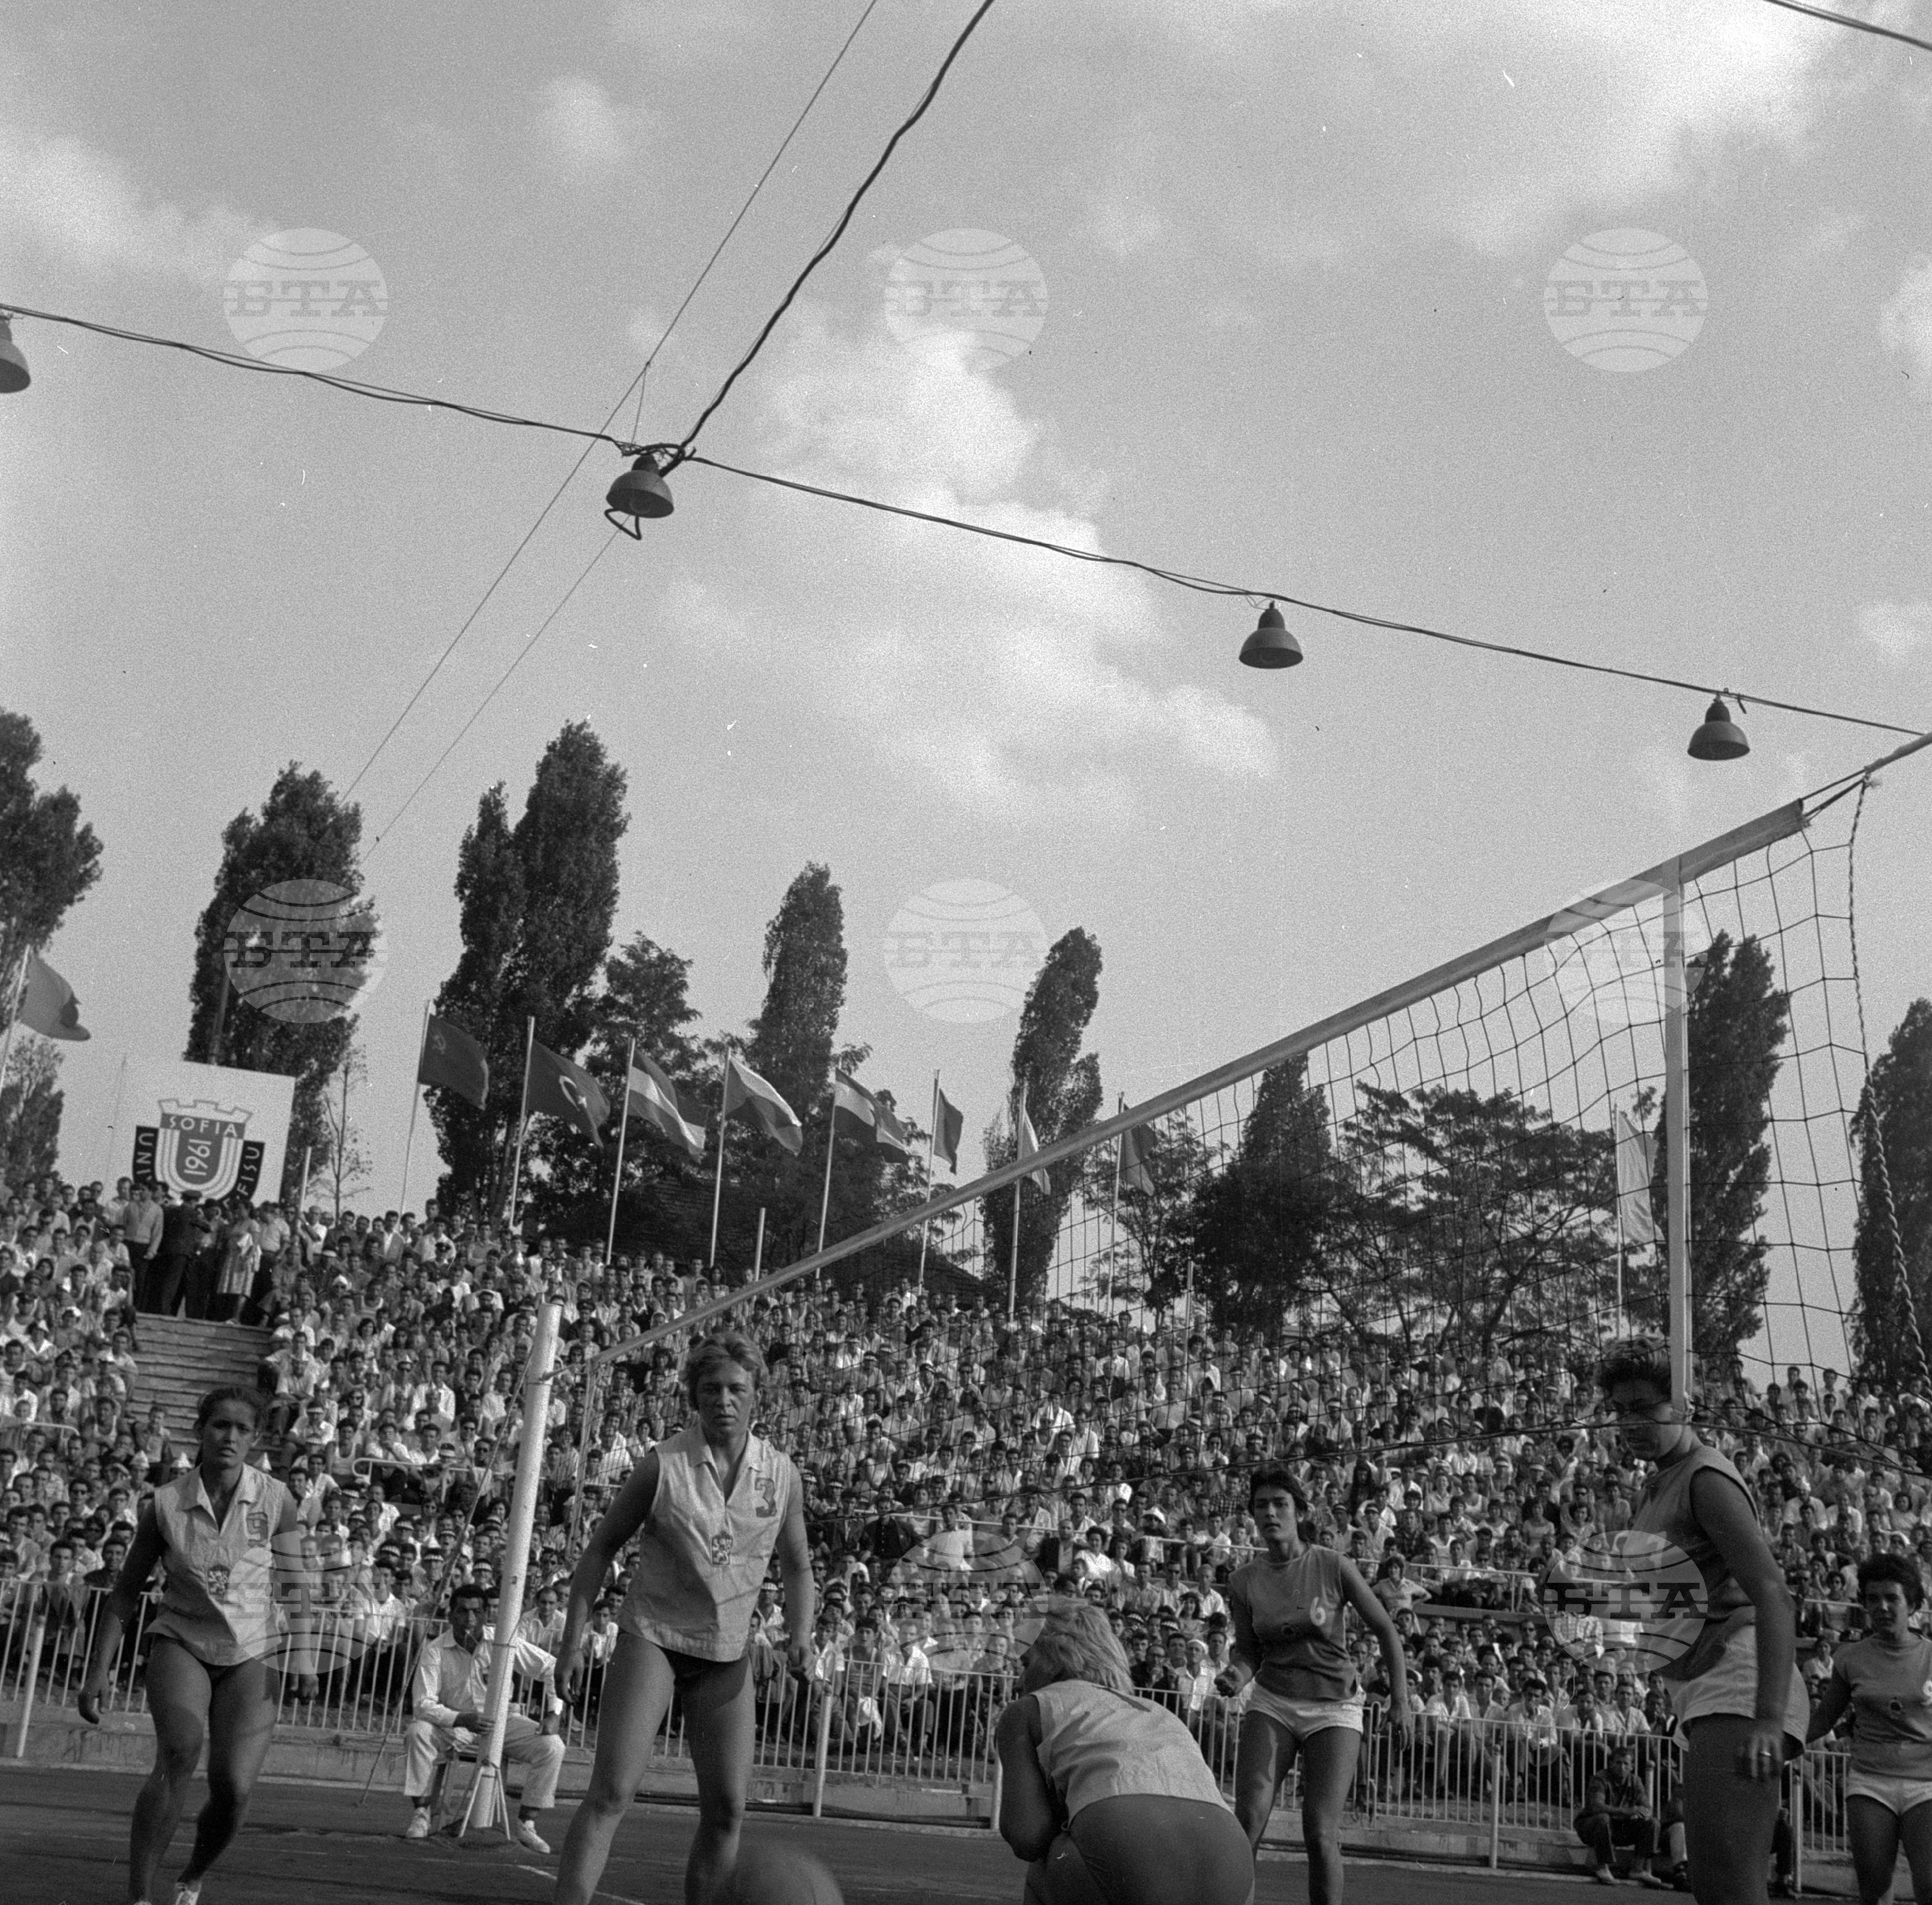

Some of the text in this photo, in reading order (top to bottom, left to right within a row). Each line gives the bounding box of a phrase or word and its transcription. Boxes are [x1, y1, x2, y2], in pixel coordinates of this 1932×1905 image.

[169, 1116, 238, 1137] SOFIA
[136, 1132, 154, 1180] UNI
[184, 1138, 212, 1176] 1961
[237, 1146, 260, 1195] FISU
[754, 1478, 777, 1518] 3
[1309, 1596, 1326, 1626] 6
